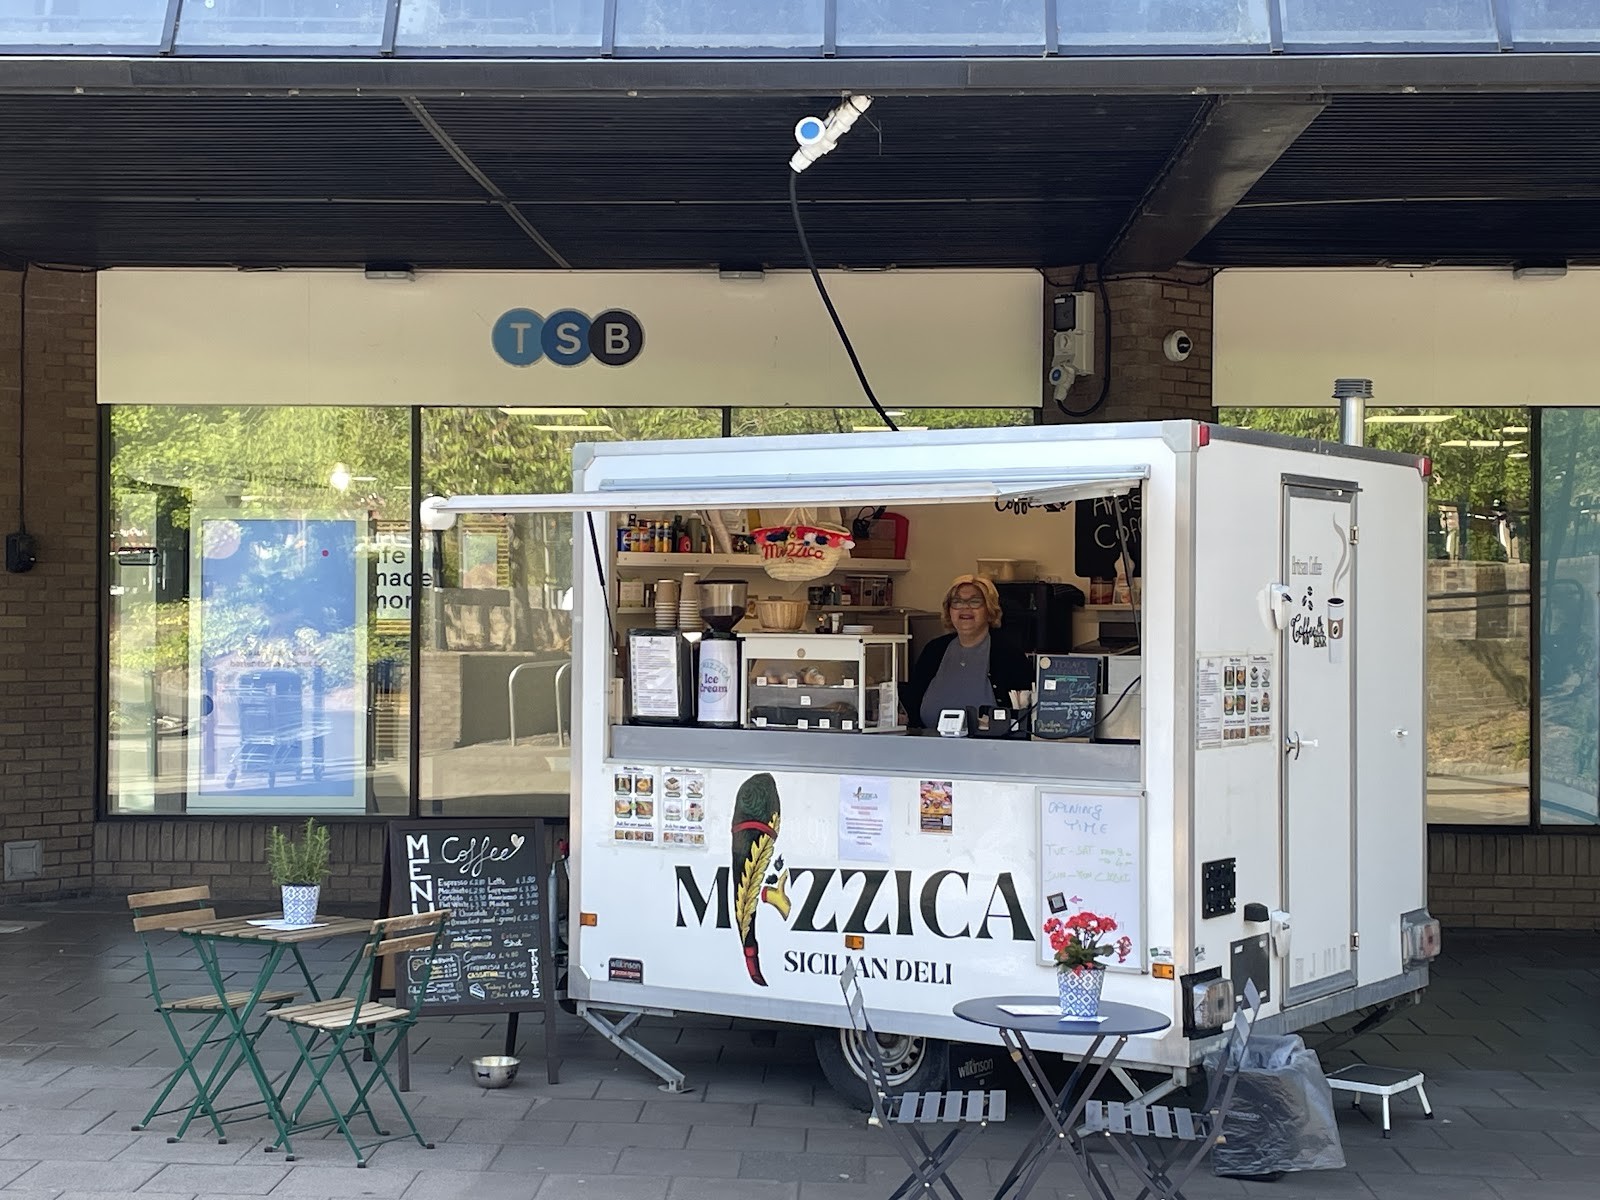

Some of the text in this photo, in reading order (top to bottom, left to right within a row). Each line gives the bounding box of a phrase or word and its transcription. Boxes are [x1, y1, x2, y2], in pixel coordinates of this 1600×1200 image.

[510, 323, 630, 354] TSB
[704, 673, 719, 684] Ice
[442, 836, 513, 877] Coffee
[438, 878, 468, 888] Espresso
[527, 949, 540, 998] TREATS
[896, 959, 952, 985] DELI
